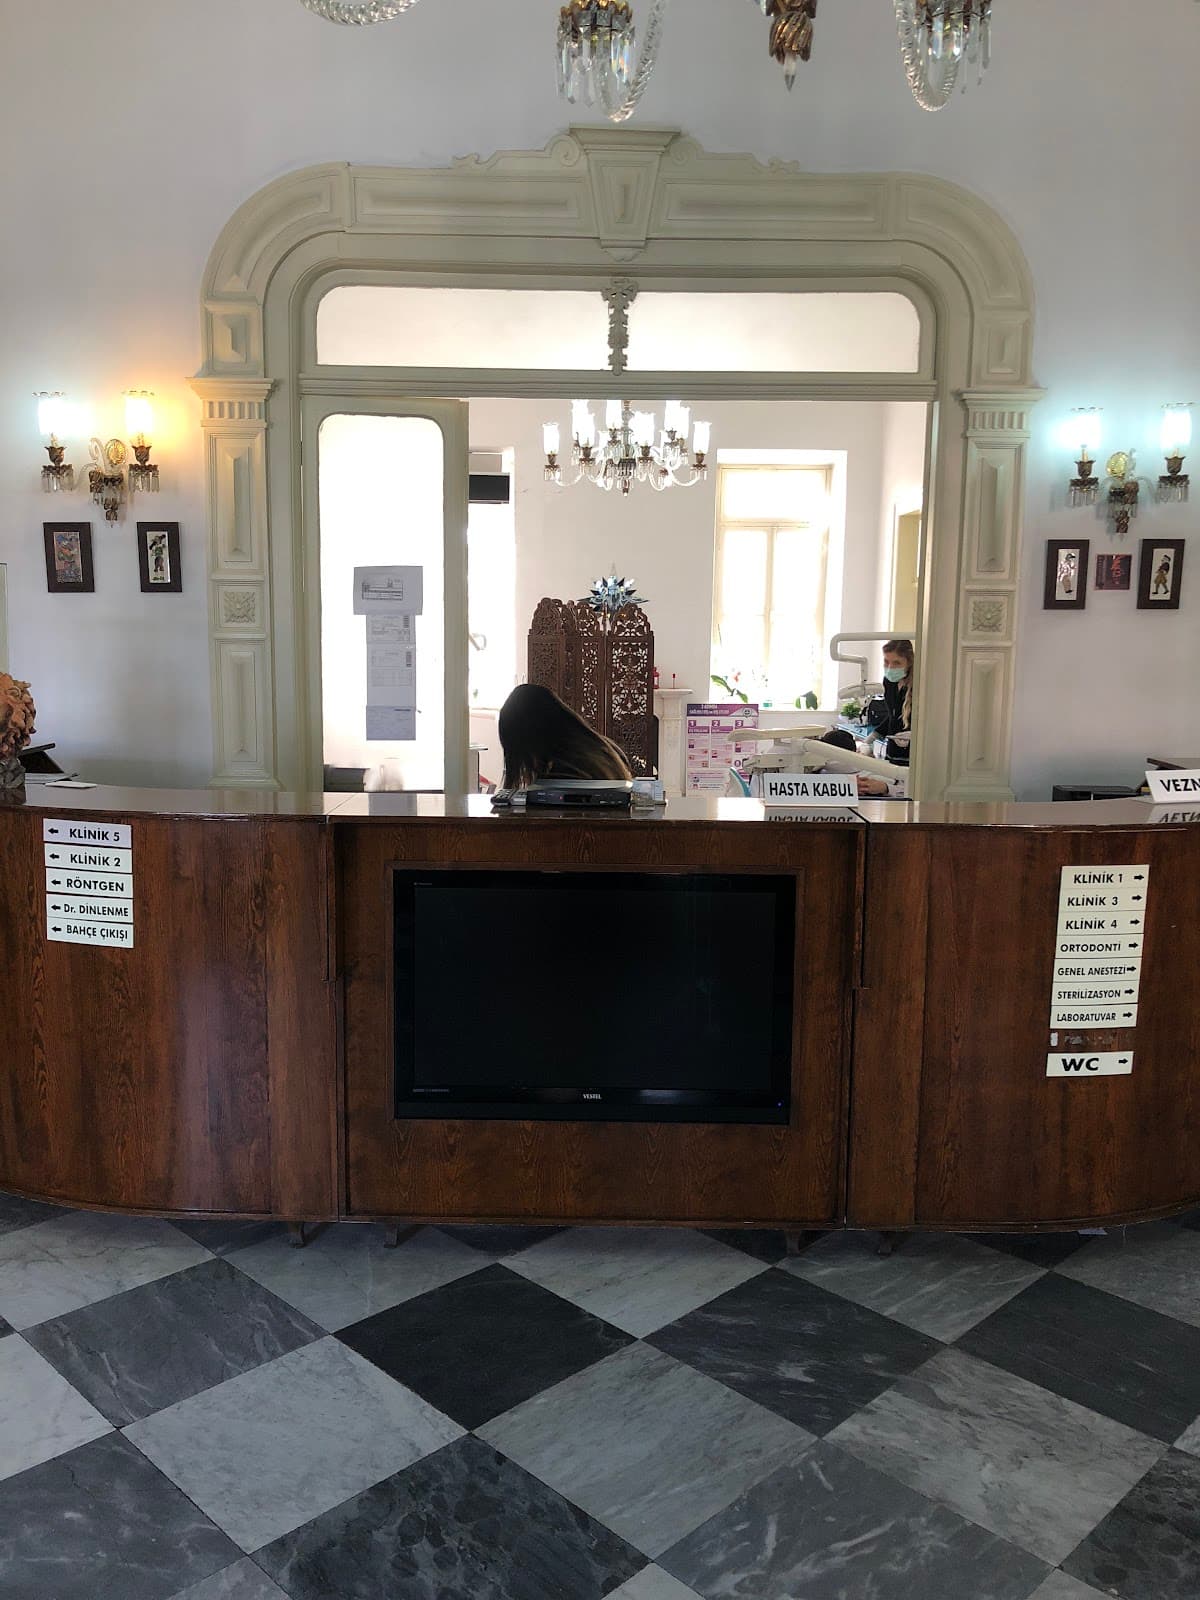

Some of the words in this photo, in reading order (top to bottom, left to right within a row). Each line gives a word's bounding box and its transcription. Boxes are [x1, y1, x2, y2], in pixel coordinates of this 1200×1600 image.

[769, 782, 809, 796] HASTA
[813, 783, 854, 797] KABUL
[69, 827, 109, 841] KLİNİK
[113, 832, 120, 841] 5
[70, 852, 110, 866] KLİNİK
[114, 857, 121, 867] 2
[66, 876, 124, 891] RÖNTGEN
[1073, 871, 1114, 884] KLİNİK
[1118, 873, 1123, 883] 1
[1067, 894, 1106, 906] KLİNİK
[1111, 896, 1118, 906] 3
[63, 904, 76, 913] Dr.
[79, 903, 129, 917] DİNLENME
[1065, 917, 1105, 930] KLİNİK
[1110, 920, 1117, 929] 4
[66, 925, 97, 938] BAHÇE
[100, 928, 128, 941] ÇIKIŞI
[1060, 940, 1121, 952] ORTODONTİ
[1057, 967, 1085, 976] GENEL
[1088, 964, 1126, 976] ANESTEZİ
[1057, 988, 1121, 1000] STERİLİZASYON
[1056, 1013, 1117, 1022] LABORATUVAR
[1061, 1057, 1099, 1072] WC
